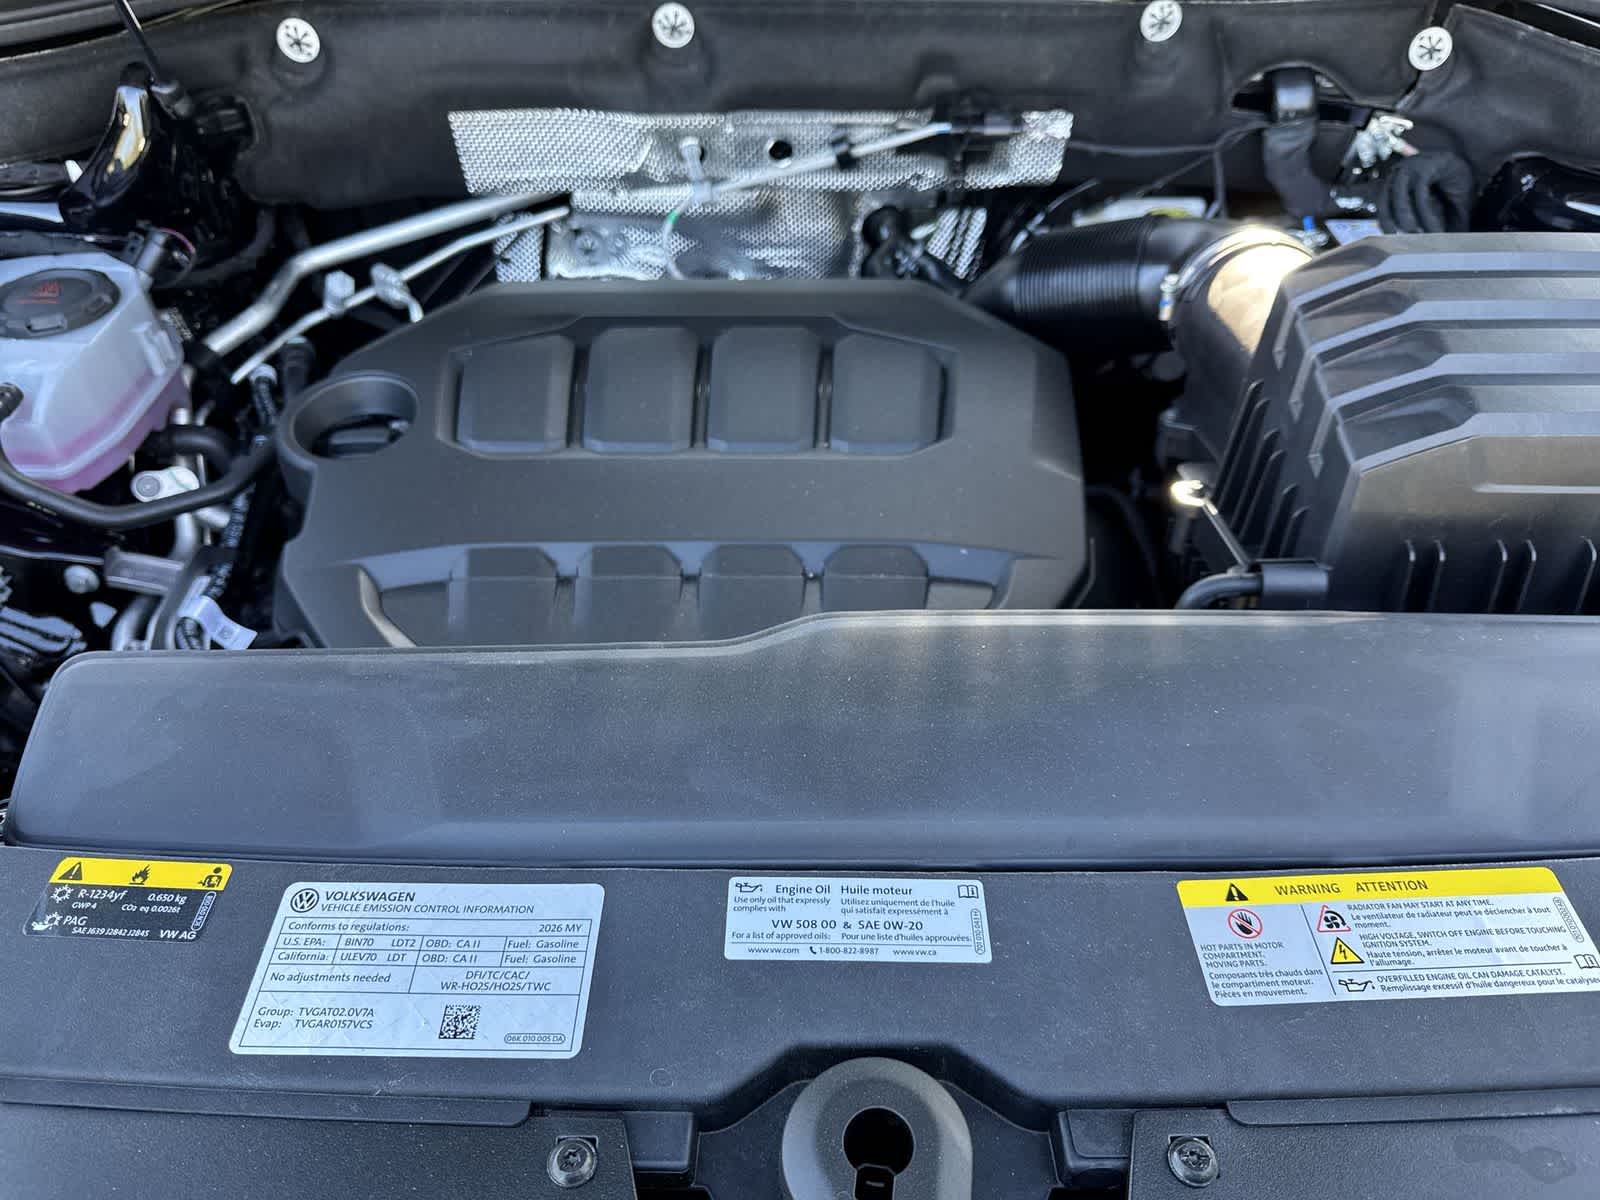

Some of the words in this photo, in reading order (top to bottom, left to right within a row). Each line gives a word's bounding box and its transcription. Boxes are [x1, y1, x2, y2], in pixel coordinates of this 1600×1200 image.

[776, 884, 812, 896] Engine
[816, 884, 830, 894] Oil
[841, 885, 870, 894] Huile
[872, 886, 912, 895] moteur
[1274, 883, 1340, 896] WARNING
[1356, 880, 1428, 893] ATTENTION
[78, 889, 128, 902] R-1234yf
[148, 894, 173, 902] 0.650
[174, 894, 188, 904] kg
[326, 891, 416, 901] VOLKSWAGEN
[750, 896, 766, 904] only
[796, 897, 830, 906] expressly
[871, 898, 918, 908] uniquement
[931, 899, 955, 907] l'huile
[322, 904, 360, 912] VEHICLE
[362, 904, 411, 912] EMISSION
[414, 905, 460, 913] CONTROL
[463, 905, 534, 914] INFORMATION
[841, 907, 854, 915] qui
[888, 908, 942, 916] expressément
[1454, 910, 1472, 918] peut
[64, 916, 88, 926] PAG
[772, 920, 792, 928] VW
[796, 920, 818, 929] 508
[821, 920, 836, 929] 00
[858, 920, 880, 930] SAE
[884, 921, 923, 930] 0W-20
[288, 922, 335, 930] Conforms
[338, 922, 350, 930] to
[351, 922, 410, 932] regulations:
[538, 924, 562, 932] 2026
[564, 924, 582, 932] MY
[1527, 926, 1566, 934] TOUCHING
[159, 930, 179, 938] VW
[180, 931, 196, 940] AG
[776, 932, 812, 942] approved
[283, 938, 302, 946] U.S.
[304, 938, 326, 946] EPA:
[344, 938, 374, 946] BIN70
[392, 939, 416, 947] LDT2
[426, 940, 452, 948] OBD:
[508, 940, 532, 948] Fuel:
[536, 940, 580, 948] Gasoline
[278, 952, 328, 960] California:
[820, 947, 879, 955] 1-800-822-8987
[1203, 952, 1265, 960] COMPARTMENT.
[340, 952, 377, 961] ULEV70
[422, 954, 448, 963] OBD:
[504, 954, 528, 964] Fuel:
[533, 954, 576, 964] Gasoline
[270, 972, 285, 981] No
[286, 972, 350, 984] adjustments
[353, 974, 392, 982] needed
[466, 971, 530, 980] DFI/TC/CAC/
[1209, 970, 1258, 980] Composants
[1258, 970, 1274, 978] très
[1275, 968, 1302, 976] chauds
[1304, 968, 1323, 976] dans
[1376, 974, 1426, 982] OVERFILLED
[1490, 970, 1523, 978] DAMAGE
[1524, 968, 1566, 976] CATALYST.
[1222, 979, 1280, 989] compartiment
[1281, 978, 1314, 986] moteur.
[1381, 984, 1432, 992] Remplissage
[1432, 980, 1464, 990] excessif
[1466, 980, 1492, 989] d'huile
[1494, 980, 1536, 988] dangereux
[1215, 990, 1241, 998] Pièces
[1254, 988, 1307, 996] mouvement.
[258, 1006, 294, 1018] Group:
[254, 1018, 282, 1030] Evap:
